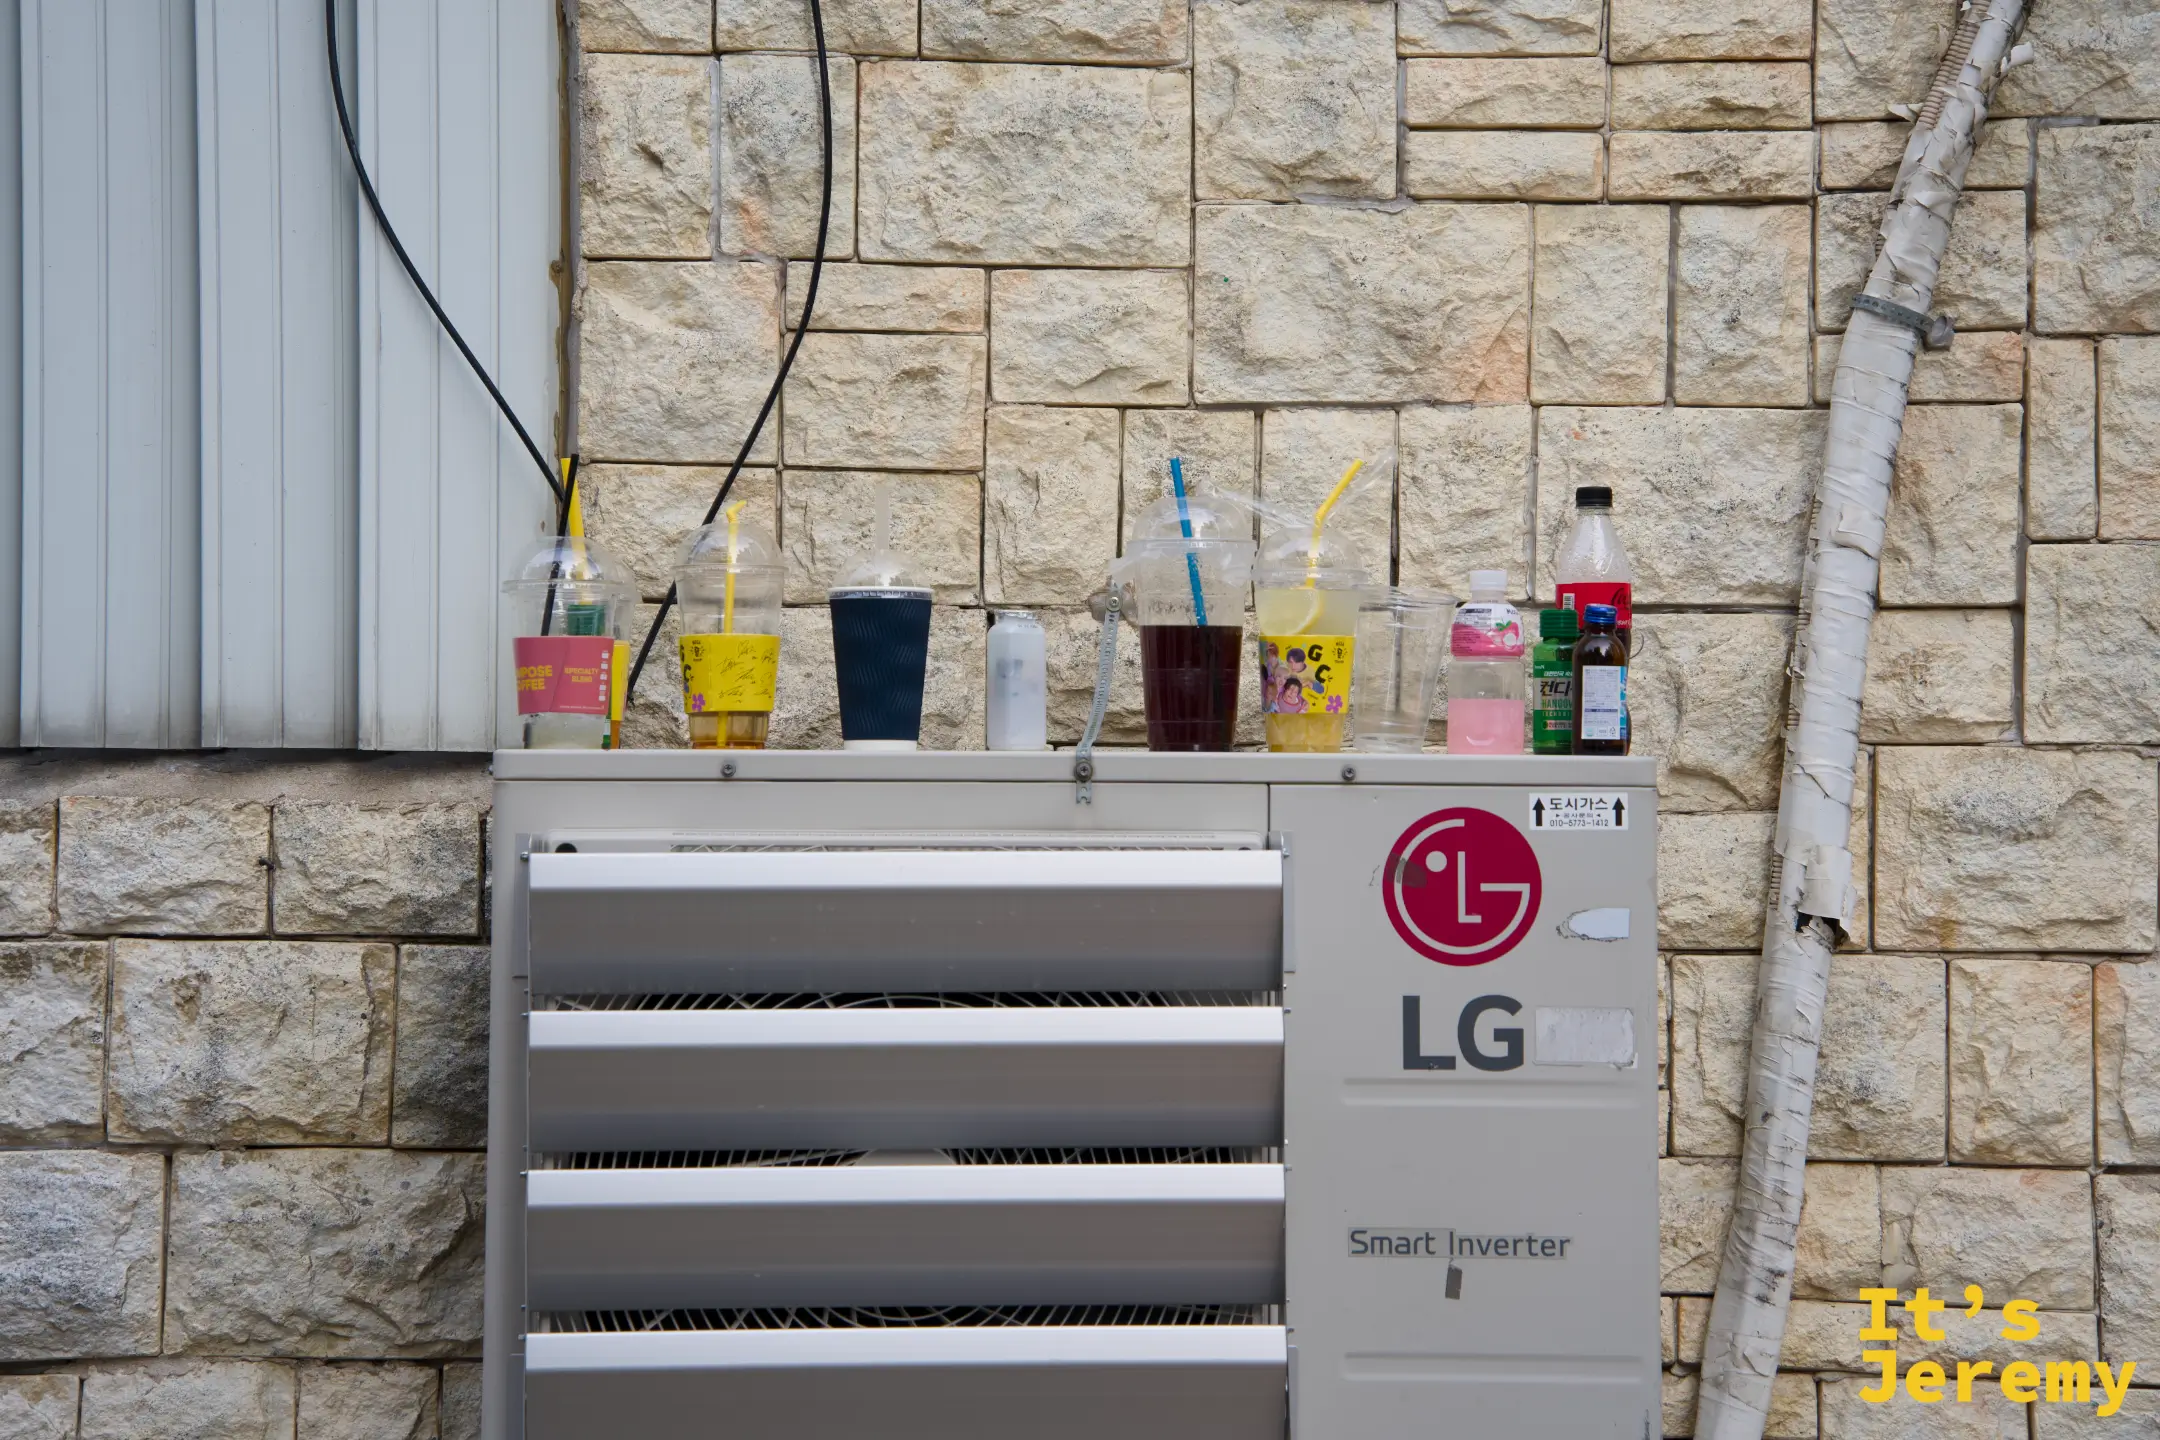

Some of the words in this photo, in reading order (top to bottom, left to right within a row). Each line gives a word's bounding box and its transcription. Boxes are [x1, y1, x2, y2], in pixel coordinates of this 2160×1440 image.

[1307, 644, 1324, 662] G
[1315, 664, 1331, 684] C
[1540, 680, 1572, 697] 컨디
[1549, 798, 1609, 811] 도시가스
[1549, 819, 1609, 827] 010-5773-1412
[1402, 994, 1525, 1072] LG
[1349, 1230, 1437, 1256] Smart
[1449, 1231, 1571, 1258] Inverter
